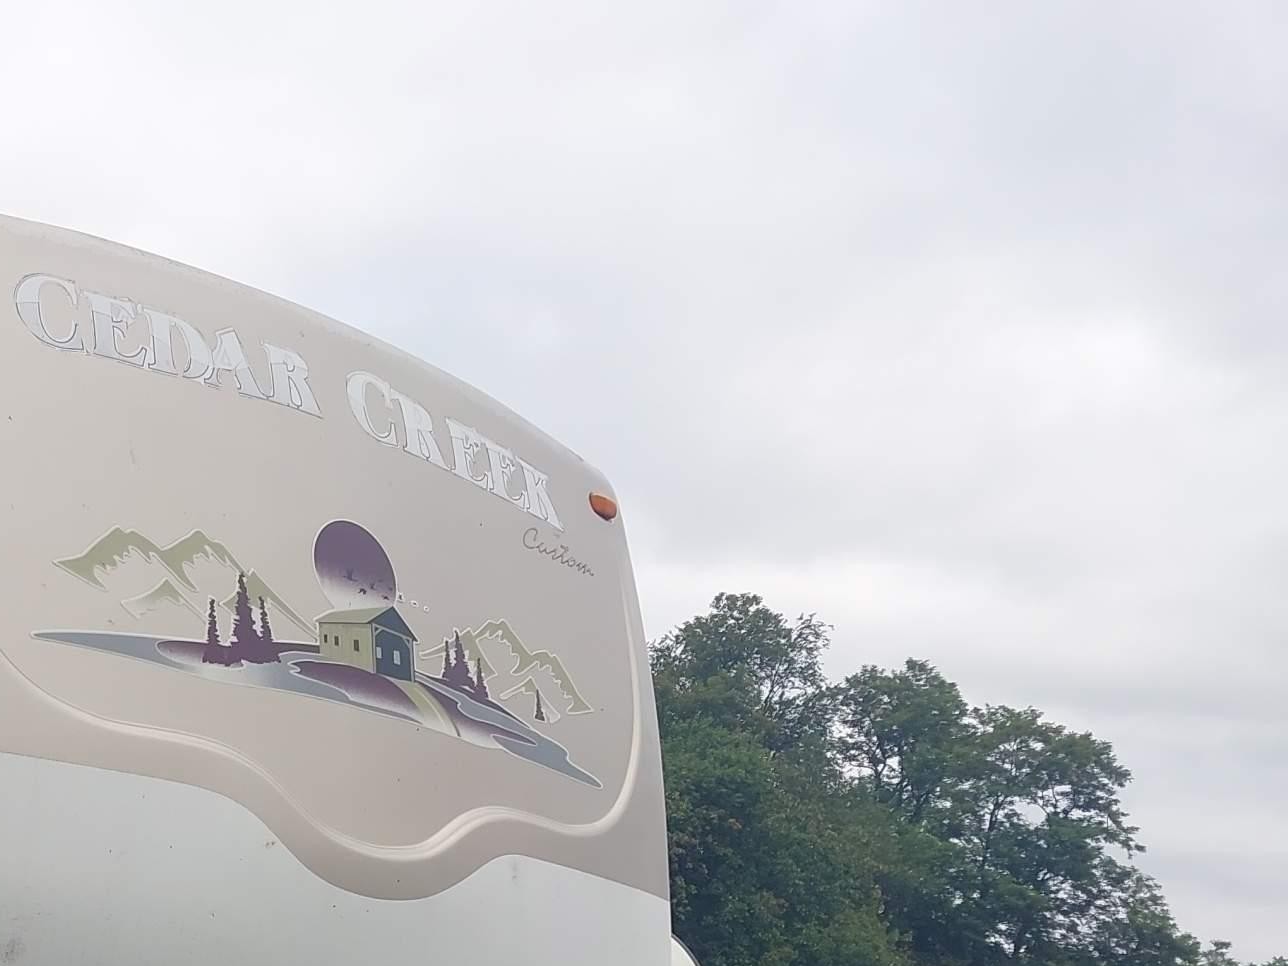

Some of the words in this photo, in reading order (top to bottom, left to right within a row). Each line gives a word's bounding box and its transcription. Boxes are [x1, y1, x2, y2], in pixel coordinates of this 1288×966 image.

[13, 272, 323, 419] CEDAR
[345, 371, 563, 532] CREEK
[522, 527, 595, 577] Custom
